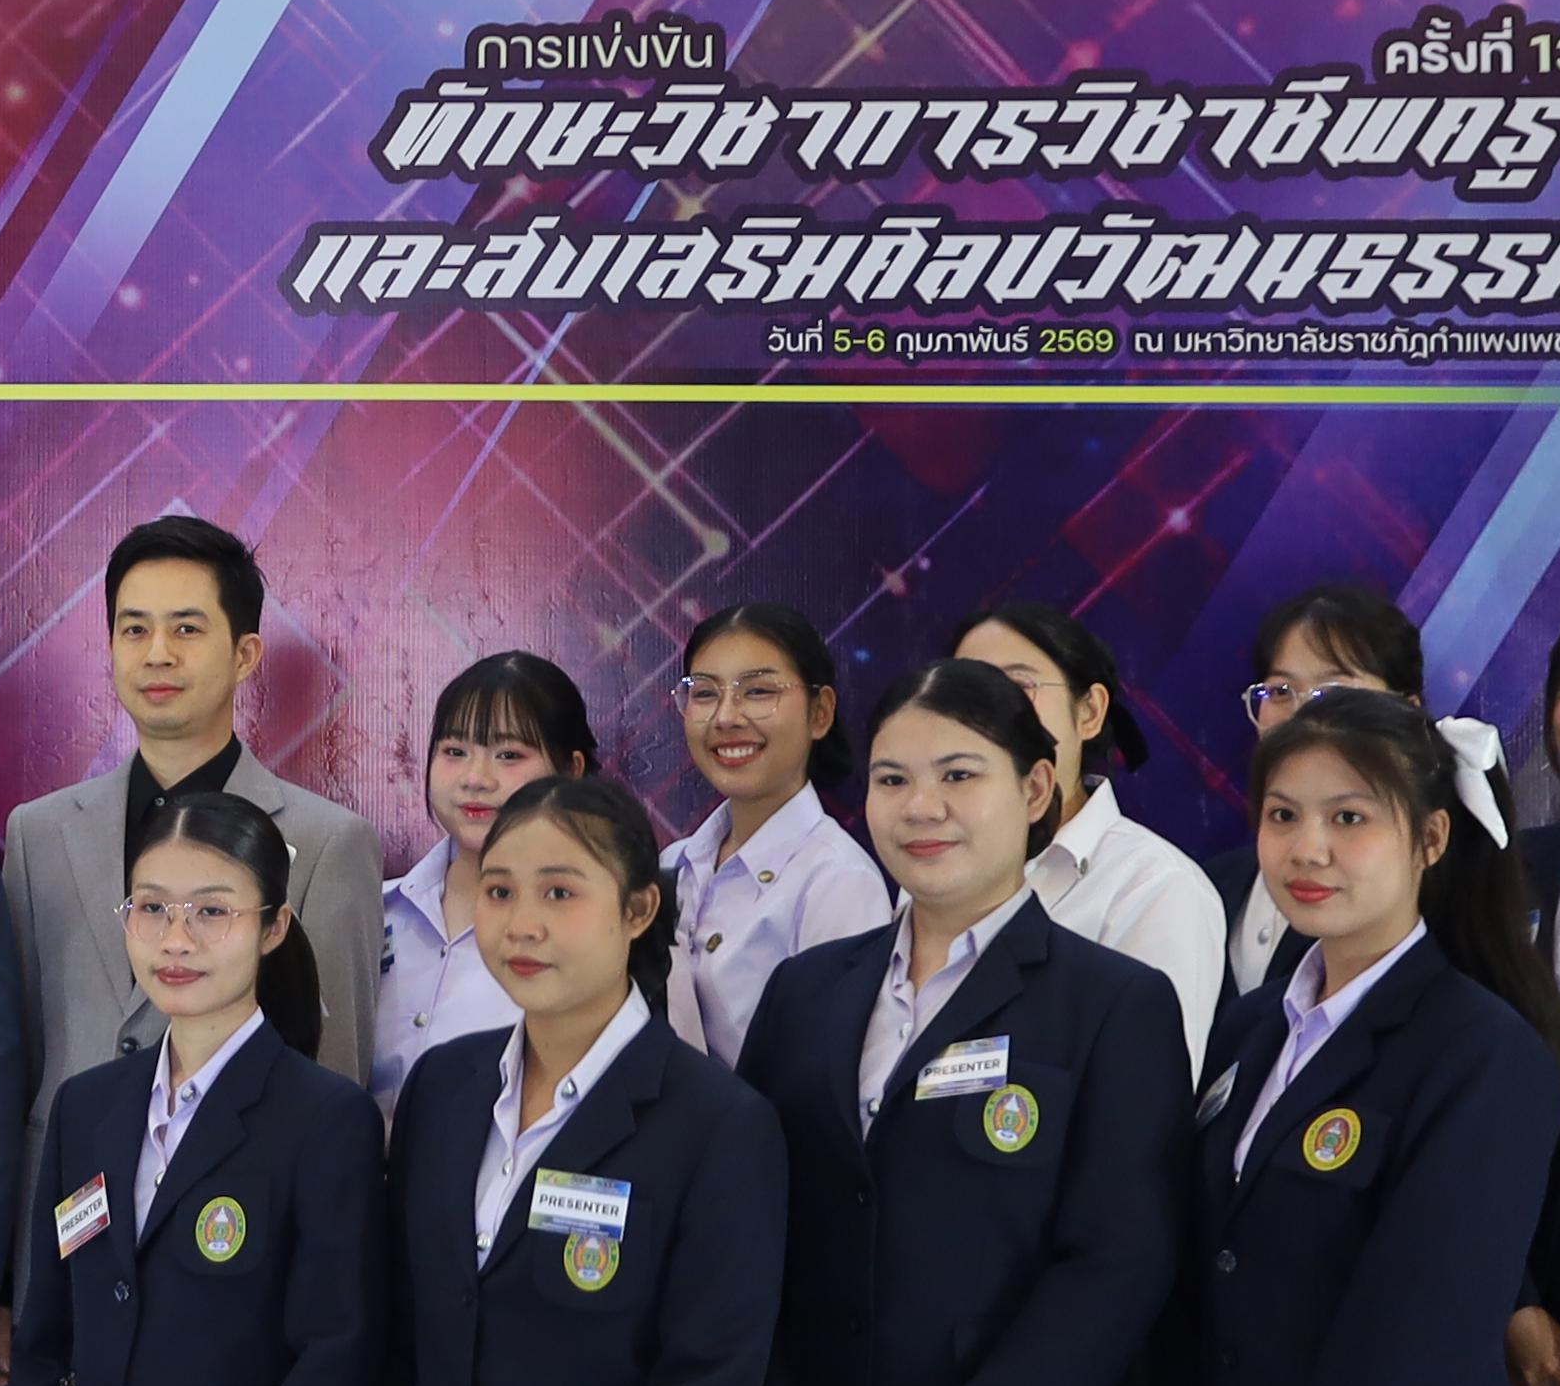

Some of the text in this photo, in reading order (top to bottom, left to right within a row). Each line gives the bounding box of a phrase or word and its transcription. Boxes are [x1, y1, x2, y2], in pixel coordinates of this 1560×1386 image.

[477, 22, 714, 70] การแข่งขัน
[1384, 18, 1513, 74] ครั้งที่
[767, 319, 824, 353] วันที่
[833, 327, 885, 353] 5-6
[895, 324, 1029, 358] กุมภาพันธ์
[1040, 328, 1114, 354] 2569
[1134, 331, 1163, 355] ณ
[924, 1059, 1000, 1077] PRESENTER
[60, 1197, 103, 1236] PRESENTER
[539, 1193, 620, 1219] PRESENTER
